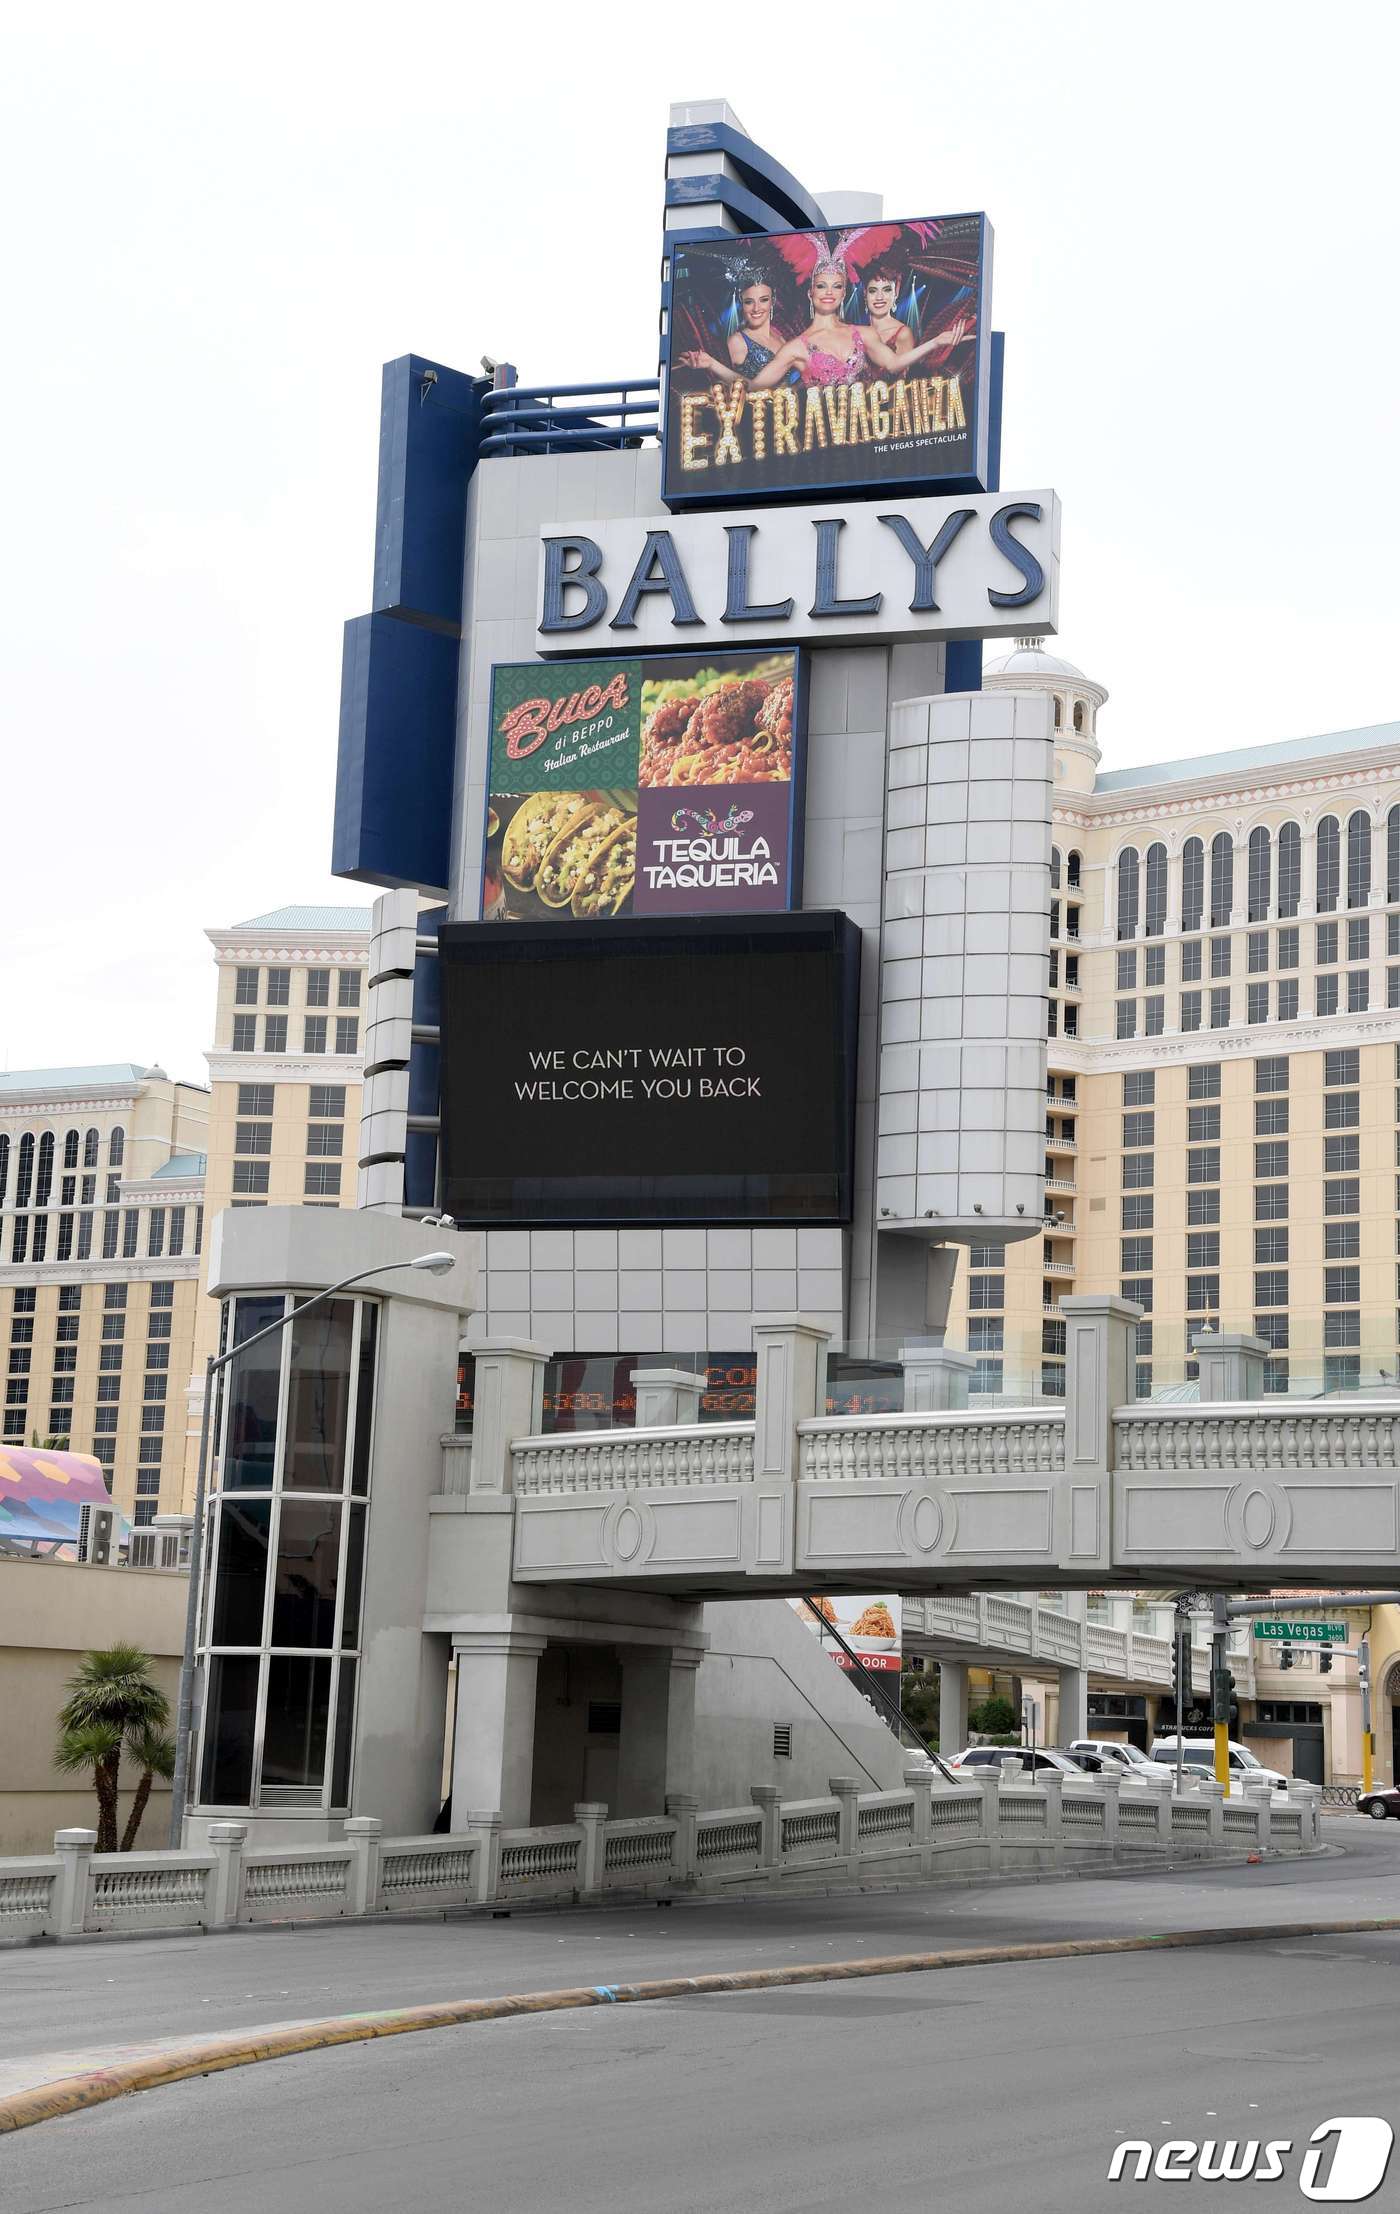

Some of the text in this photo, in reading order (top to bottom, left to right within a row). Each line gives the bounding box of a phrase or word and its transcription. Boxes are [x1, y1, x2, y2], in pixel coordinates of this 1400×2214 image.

[680, 375, 967, 471] EXTRAVAGANZA
[874, 432, 968, 453] THE VEGAS SPECTACULAR
[537, 502, 1044, 634] BALLYS
[501, 672, 629, 760] BUCA
[555, 715, 613, 751] di BEPPO
[544, 727, 631, 773] Italian Restaurant
[653, 836, 771, 863] TEQUILA
[643, 862, 778, 889] TAQUERIA
[528, 1047, 746, 1070] WE CAN'T WAIT TO
[514, 1077, 762, 1101] WELCOME YOU BACK
[1263, 1623, 1284, 1636] Las
[1288, 1623, 1324, 1640] Vegas
